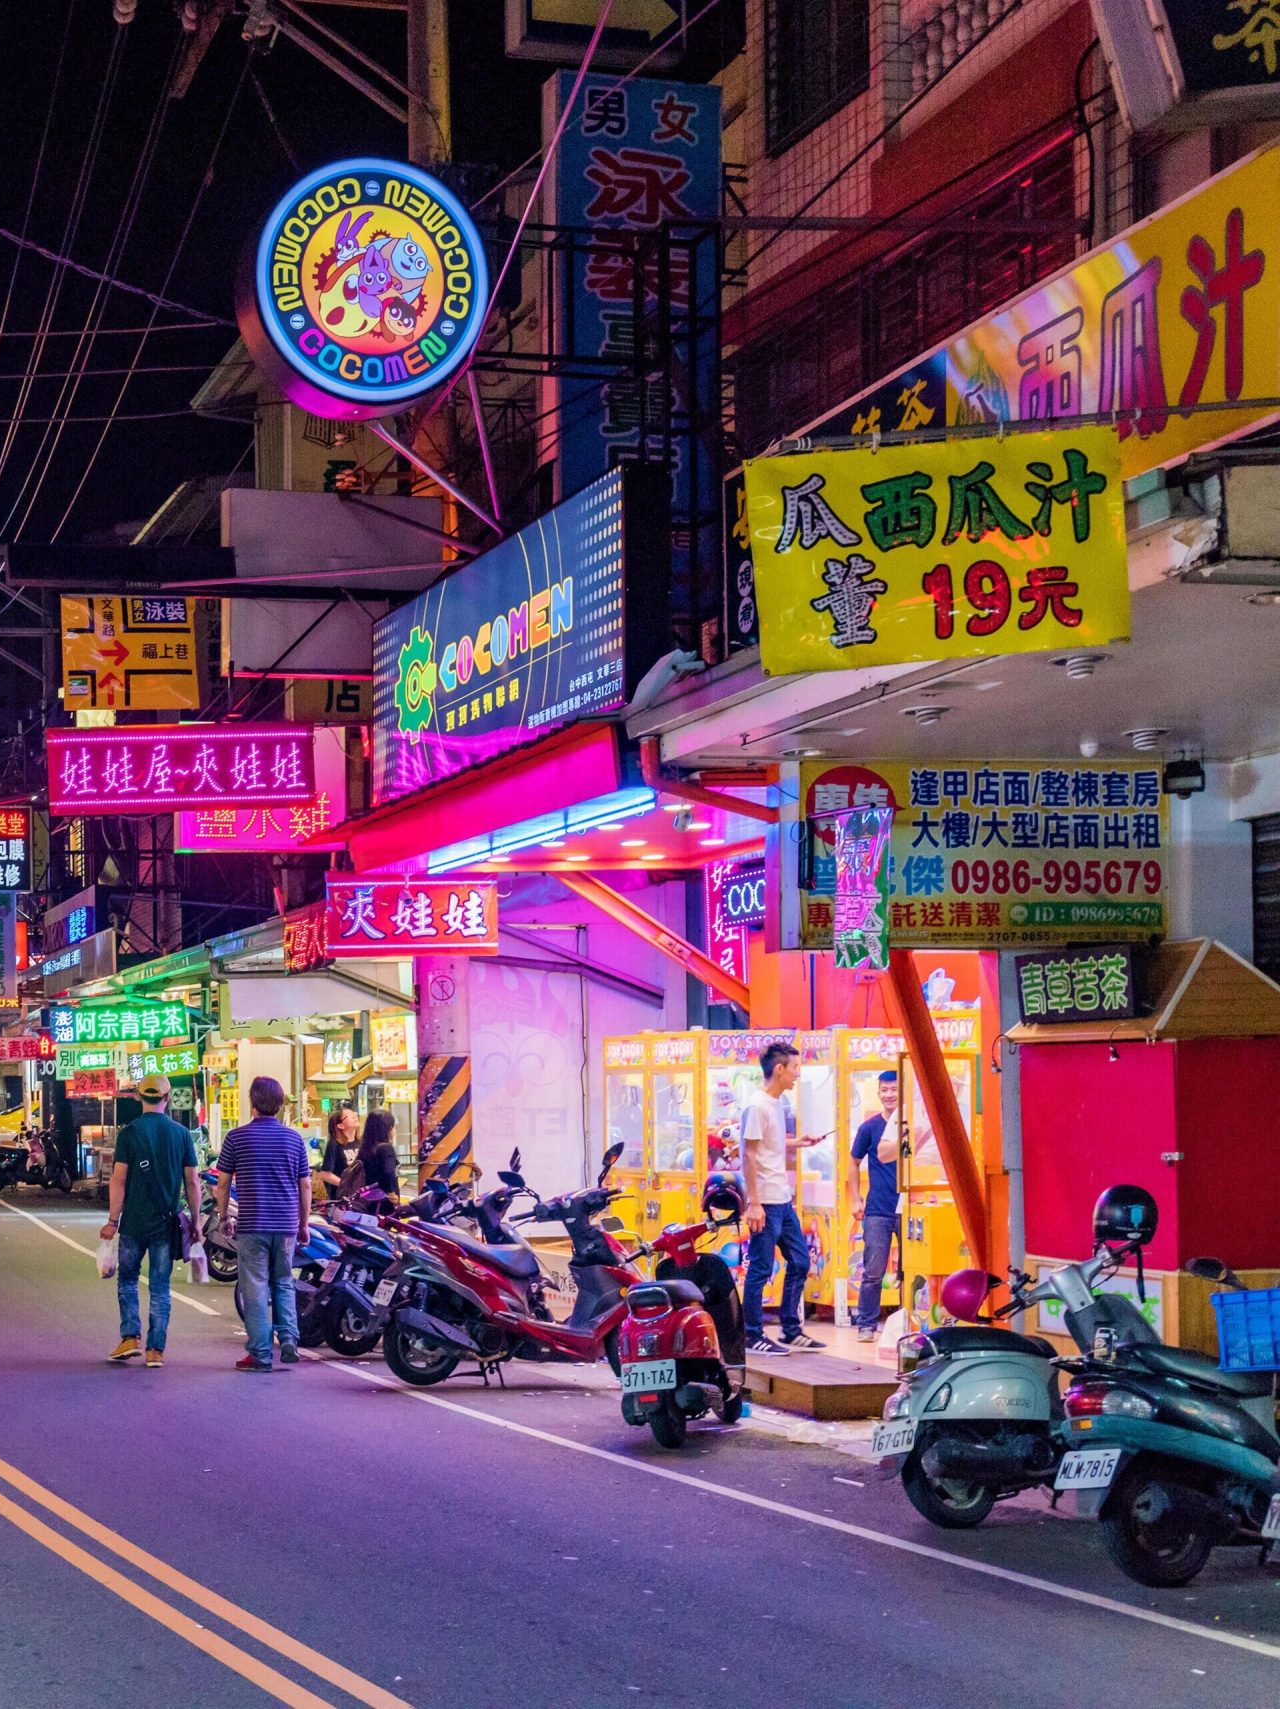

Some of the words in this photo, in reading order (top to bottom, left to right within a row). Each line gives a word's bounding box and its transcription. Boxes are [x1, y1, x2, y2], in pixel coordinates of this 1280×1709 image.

[582, 86, 697, 146] 男女
[272, 177, 362, 312] COCOMEN
[383, 179, 472, 320] COCOMEN
[298, 327, 448, 384] COCOMEN
[861, 449, 1108, 552] 西瓜汁
[146, 601, 187, 622] 泳裝
[921, 560, 1084, 640] 19元
[141, 643, 189, 661] 福上巷
[439, 576, 573, 693] COCOMEN
[910, 768, 1160, 809] 逢甲店面/整棟套房
[911, 811, 1161, 851] 大樓/大型店面出租
[951, 859, 1162, 896] 0986-995679
[341, 885, 489, 940] 夾娃娃
[1021, 953, 1129, 1017] 青草苦茶
[55, 1011, 74, 1042] 澎湖
[76, 1007, 185, 1040] 阿宗青草茶
[623, 1368, 675, 1389] 371-TAZ
